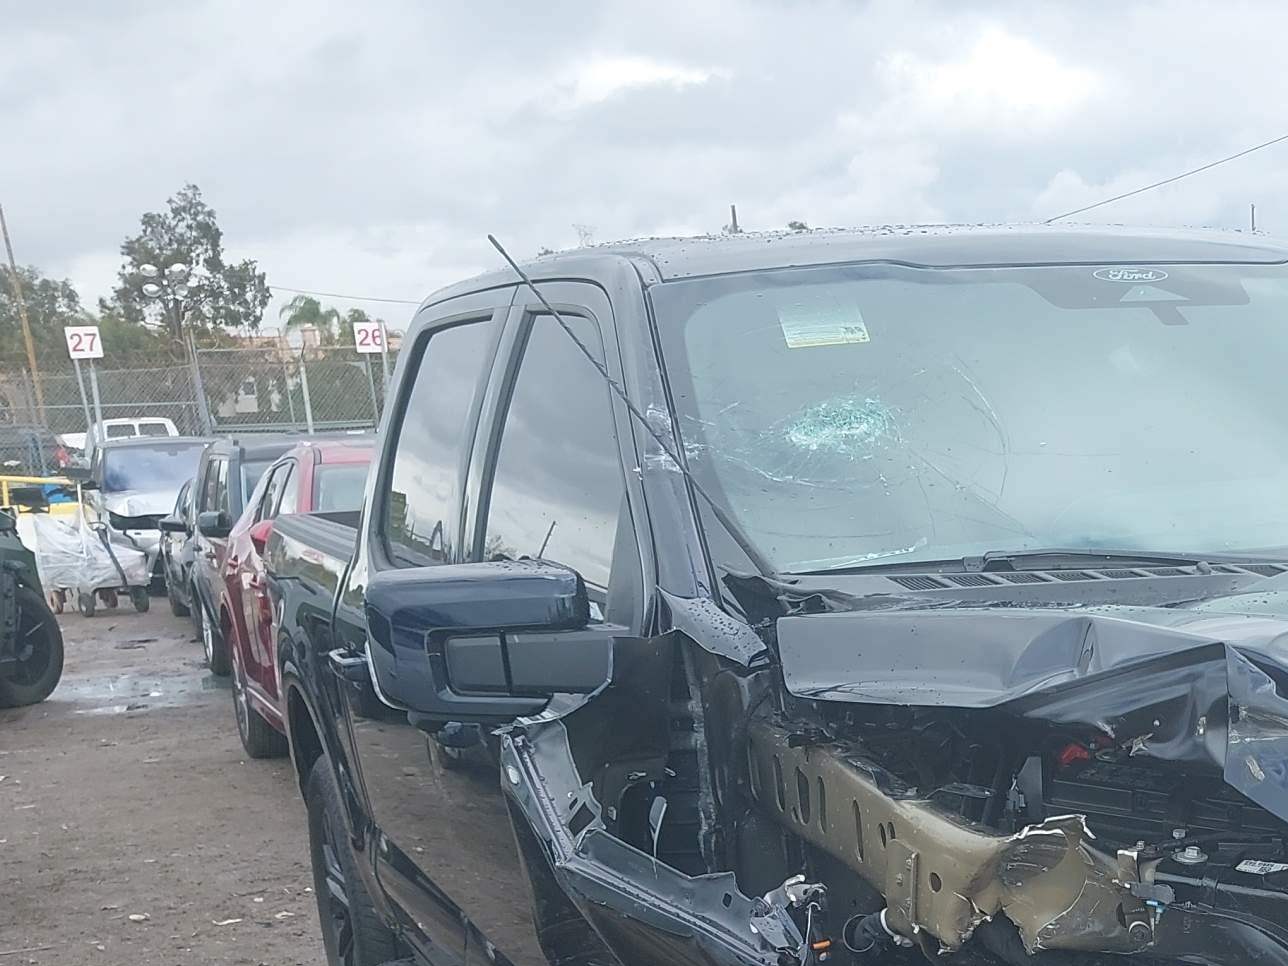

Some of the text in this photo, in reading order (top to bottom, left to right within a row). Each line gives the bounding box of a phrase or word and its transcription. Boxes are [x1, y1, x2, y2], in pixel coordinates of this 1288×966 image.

[1108, 270, 1156, 280] Ford
[70, 333, 97, 352] 27
[358, 329, 383, 347] 26
